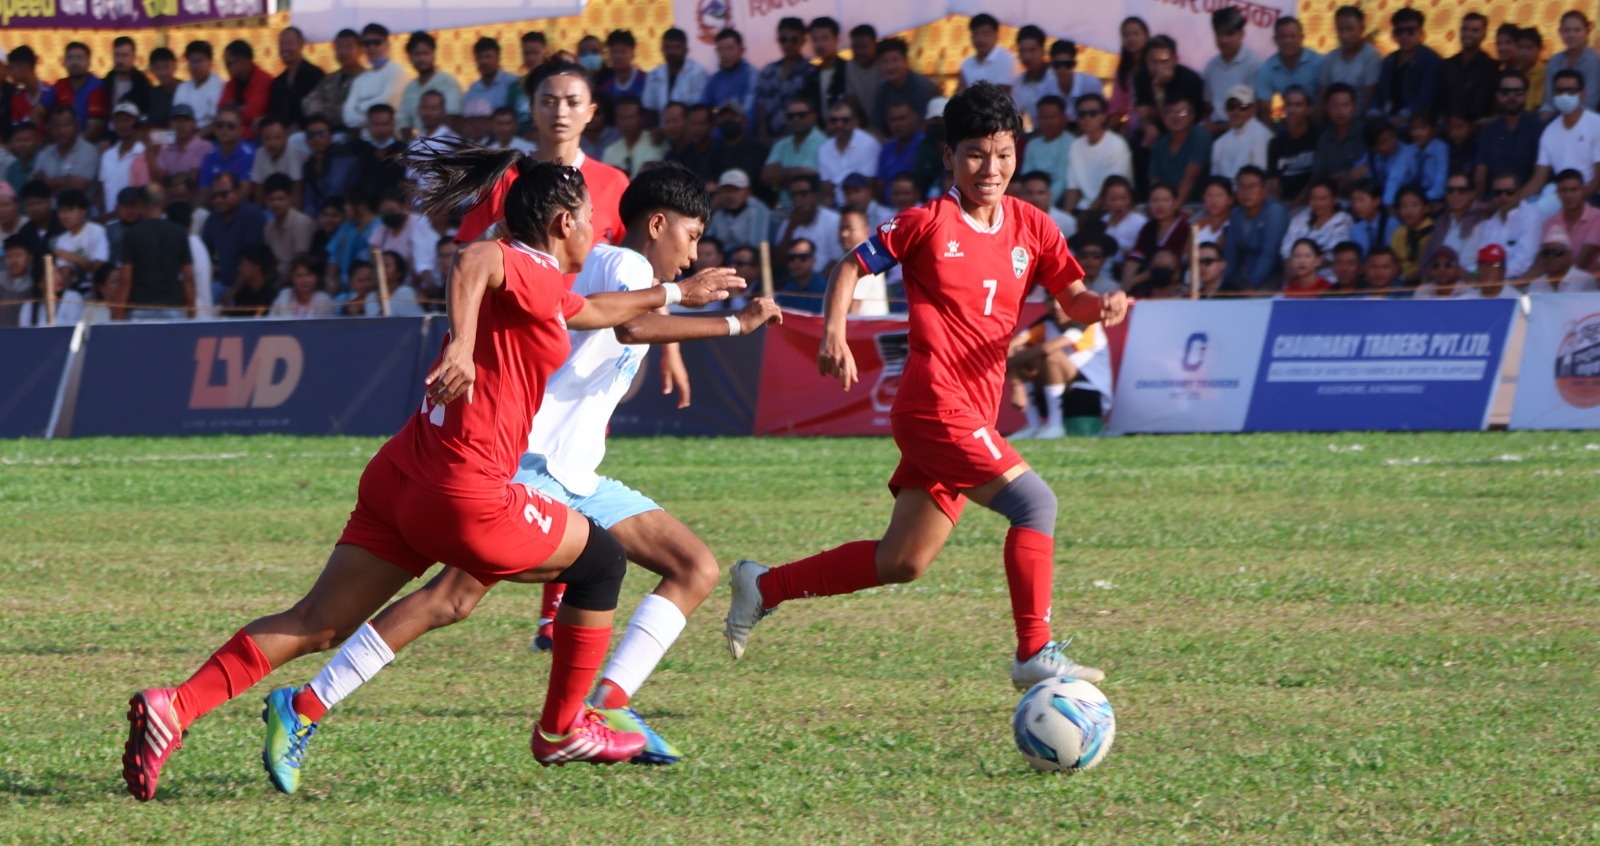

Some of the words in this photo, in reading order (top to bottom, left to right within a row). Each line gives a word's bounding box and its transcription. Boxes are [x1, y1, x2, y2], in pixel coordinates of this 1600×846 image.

[0, 0, 55, 26] peed
[982, 279, 998, 316] 7
[1272, 334, 1362, 359] CHAUDHARY
[1361, 334, 1429, 358] TRADERS
[972, 426, 1003, 461] 7
